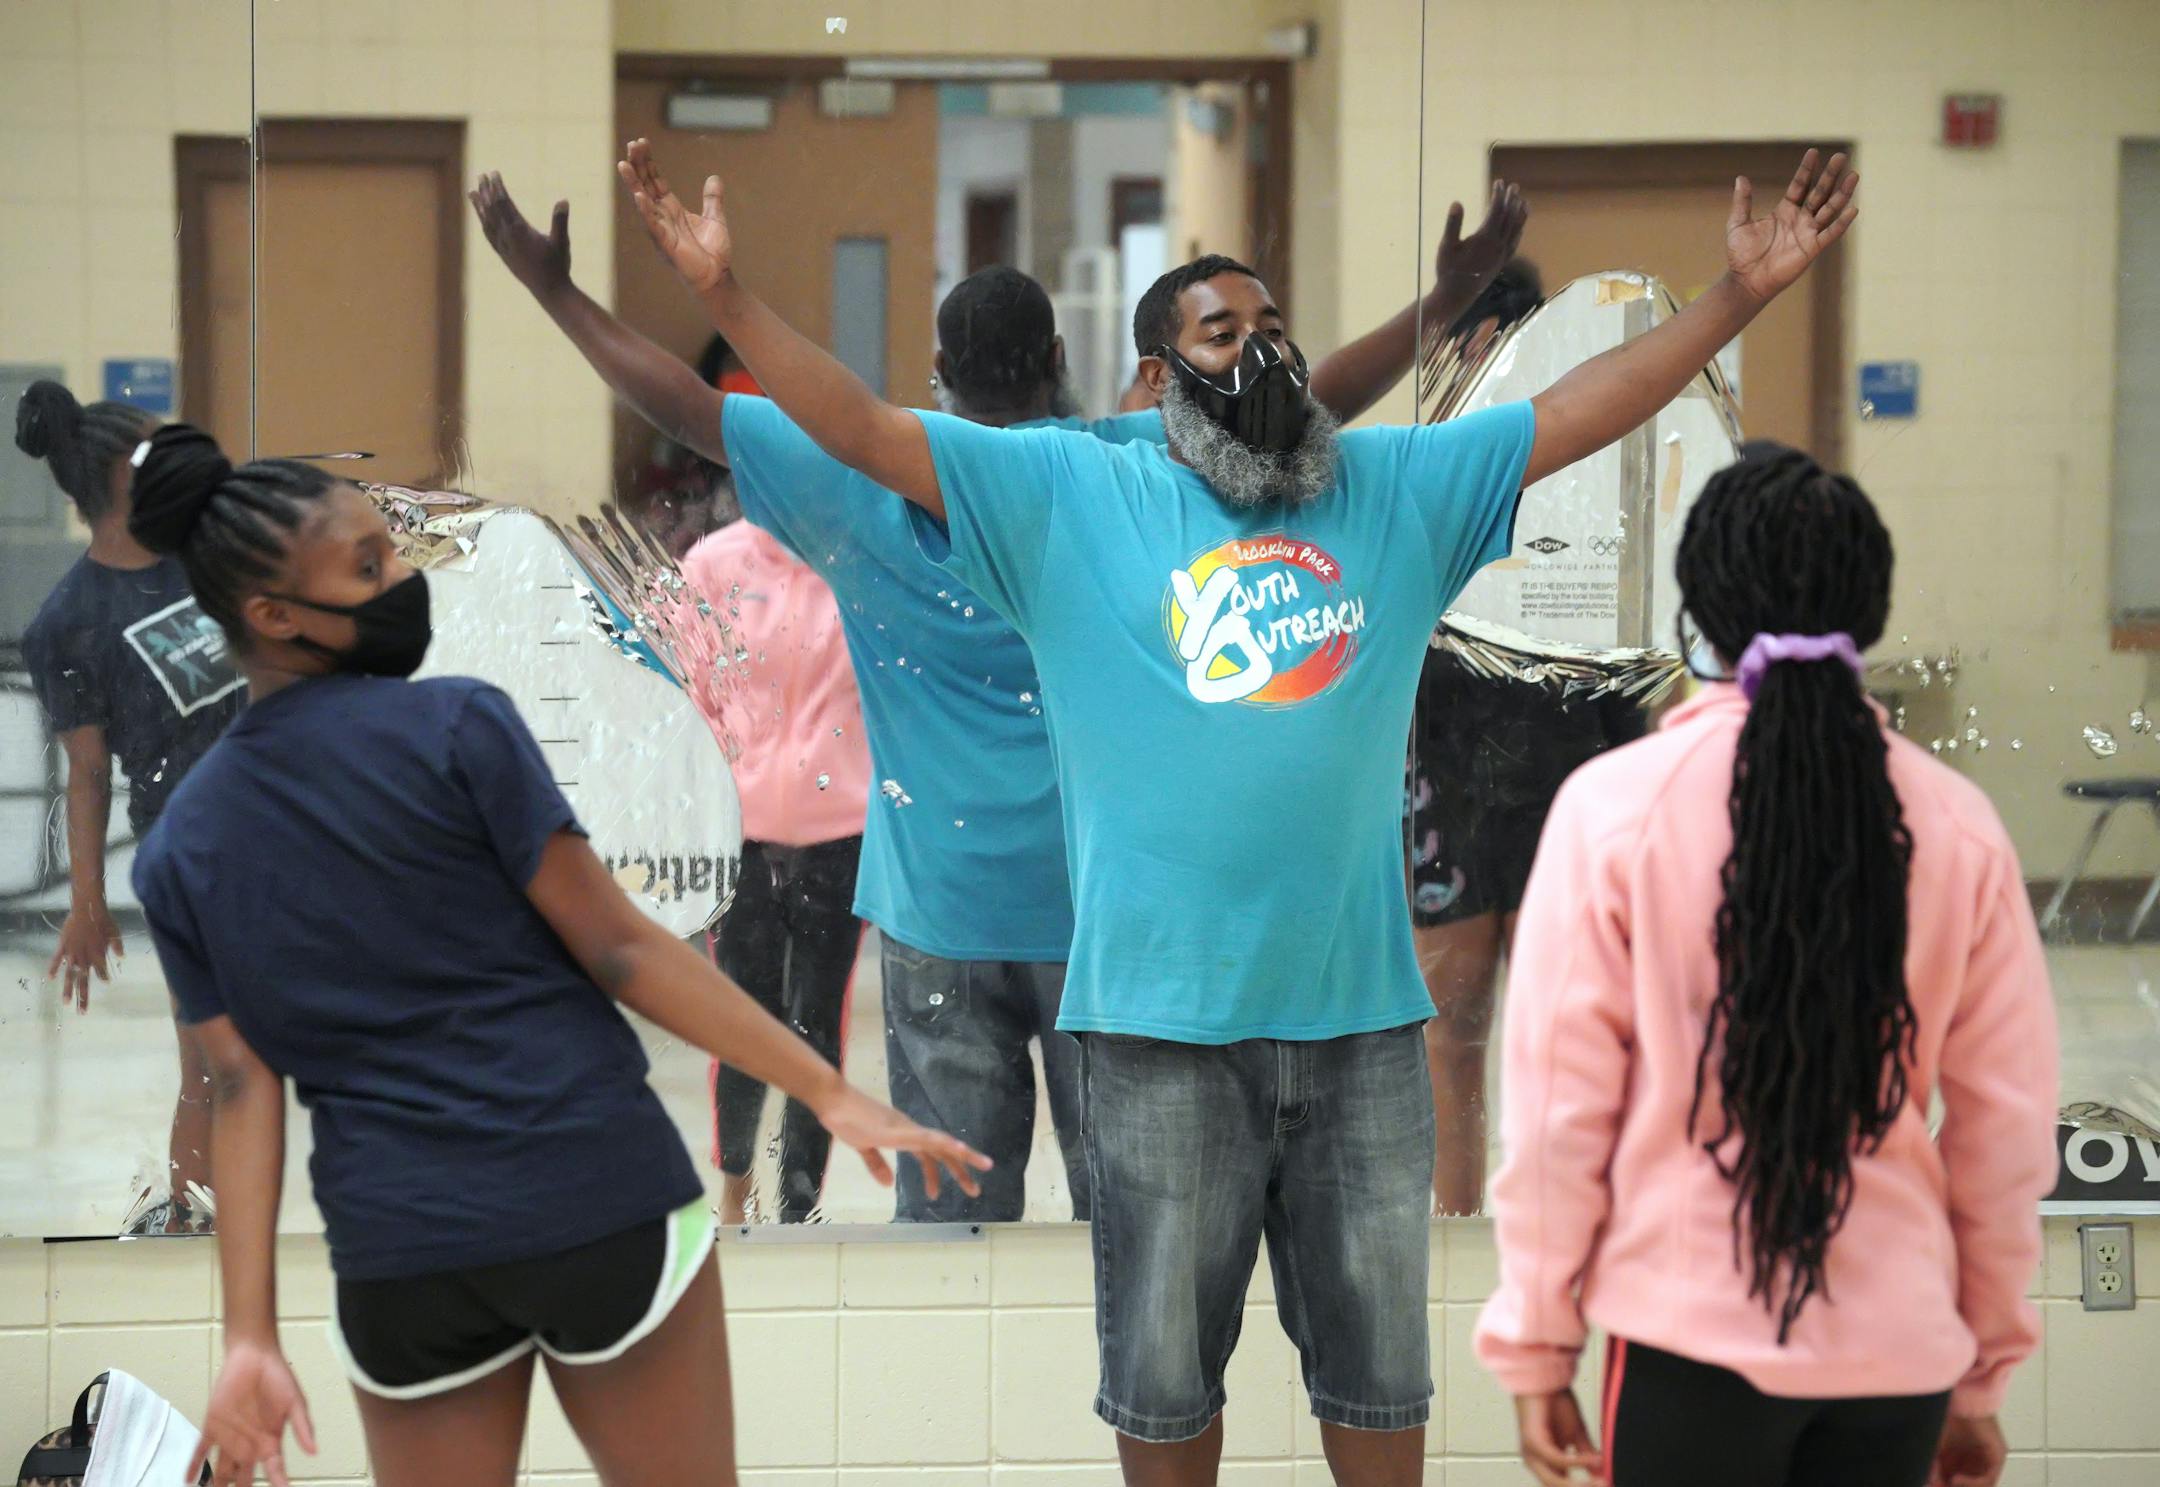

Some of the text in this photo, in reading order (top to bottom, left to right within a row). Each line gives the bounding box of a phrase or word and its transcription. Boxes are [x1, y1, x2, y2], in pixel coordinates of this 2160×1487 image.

[1299, 546, 1334, 577] PARK
[1590, 582, 1618, 591] RESPO
[1170, 565, 1300, 662] YOUTH
[1186, 594, 1365, 703] OUTREACH
